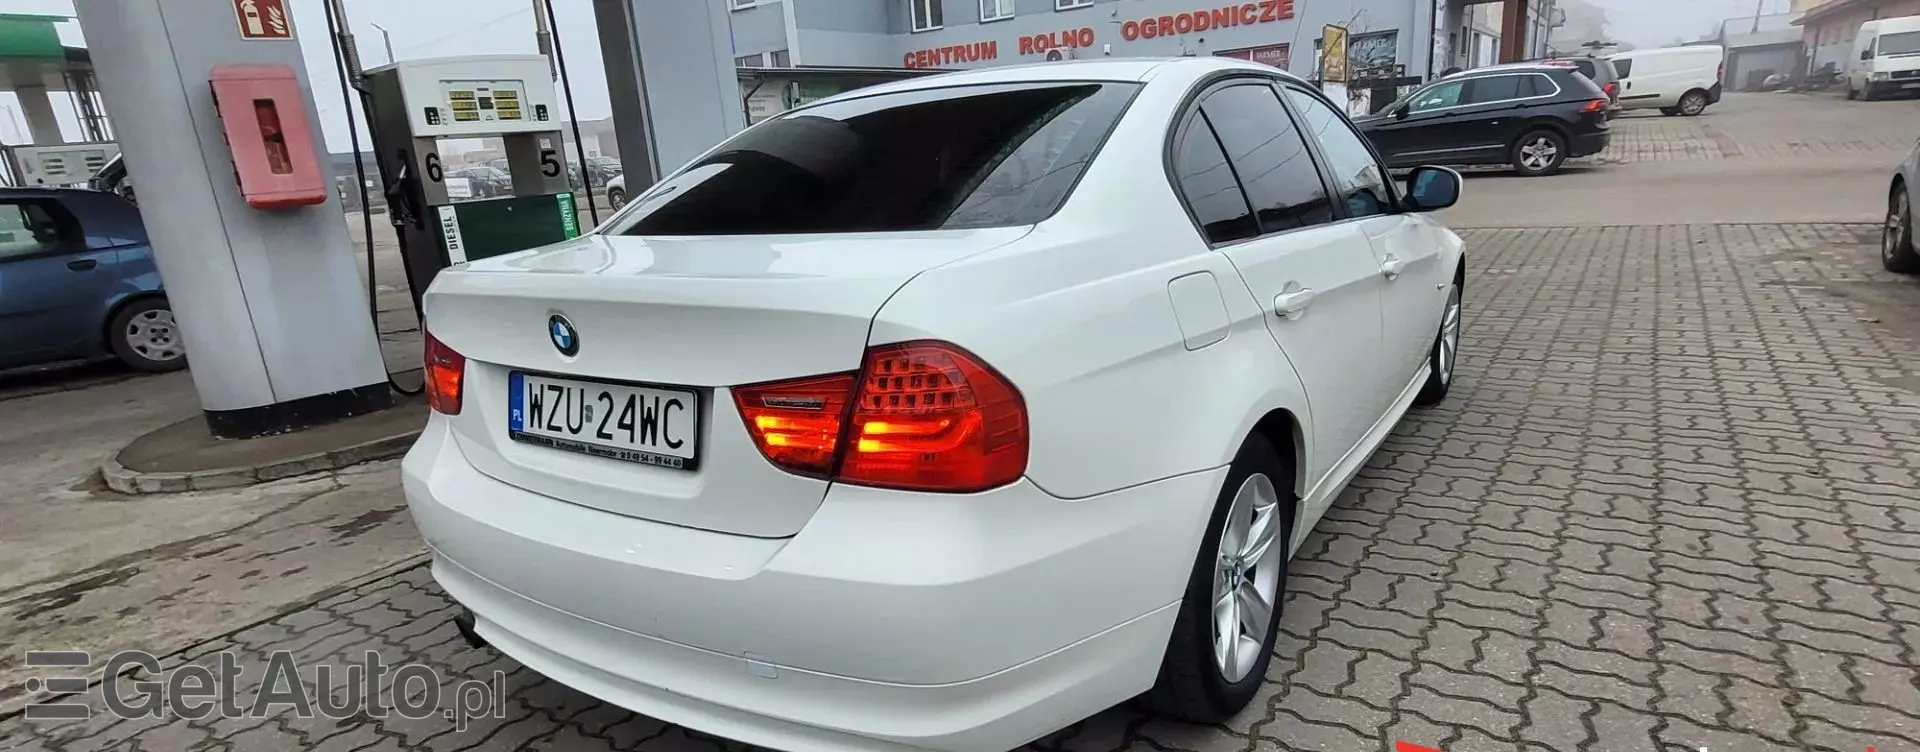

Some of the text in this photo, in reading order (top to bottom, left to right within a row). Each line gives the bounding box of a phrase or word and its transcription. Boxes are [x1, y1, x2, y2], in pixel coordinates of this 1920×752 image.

[903, 0, 1294, 69] CENTRUM ROLNO OGRODNICZE
[425, 152, 443, 183] 6
[541, 149, 561, 178] 5
[561, 200, 575, 231] BENZYNA
[443, 216, 459, 251] DIESEL
[512, 408, 523, 421] PL
[528, 382, 684, 449] WZU 24WC
